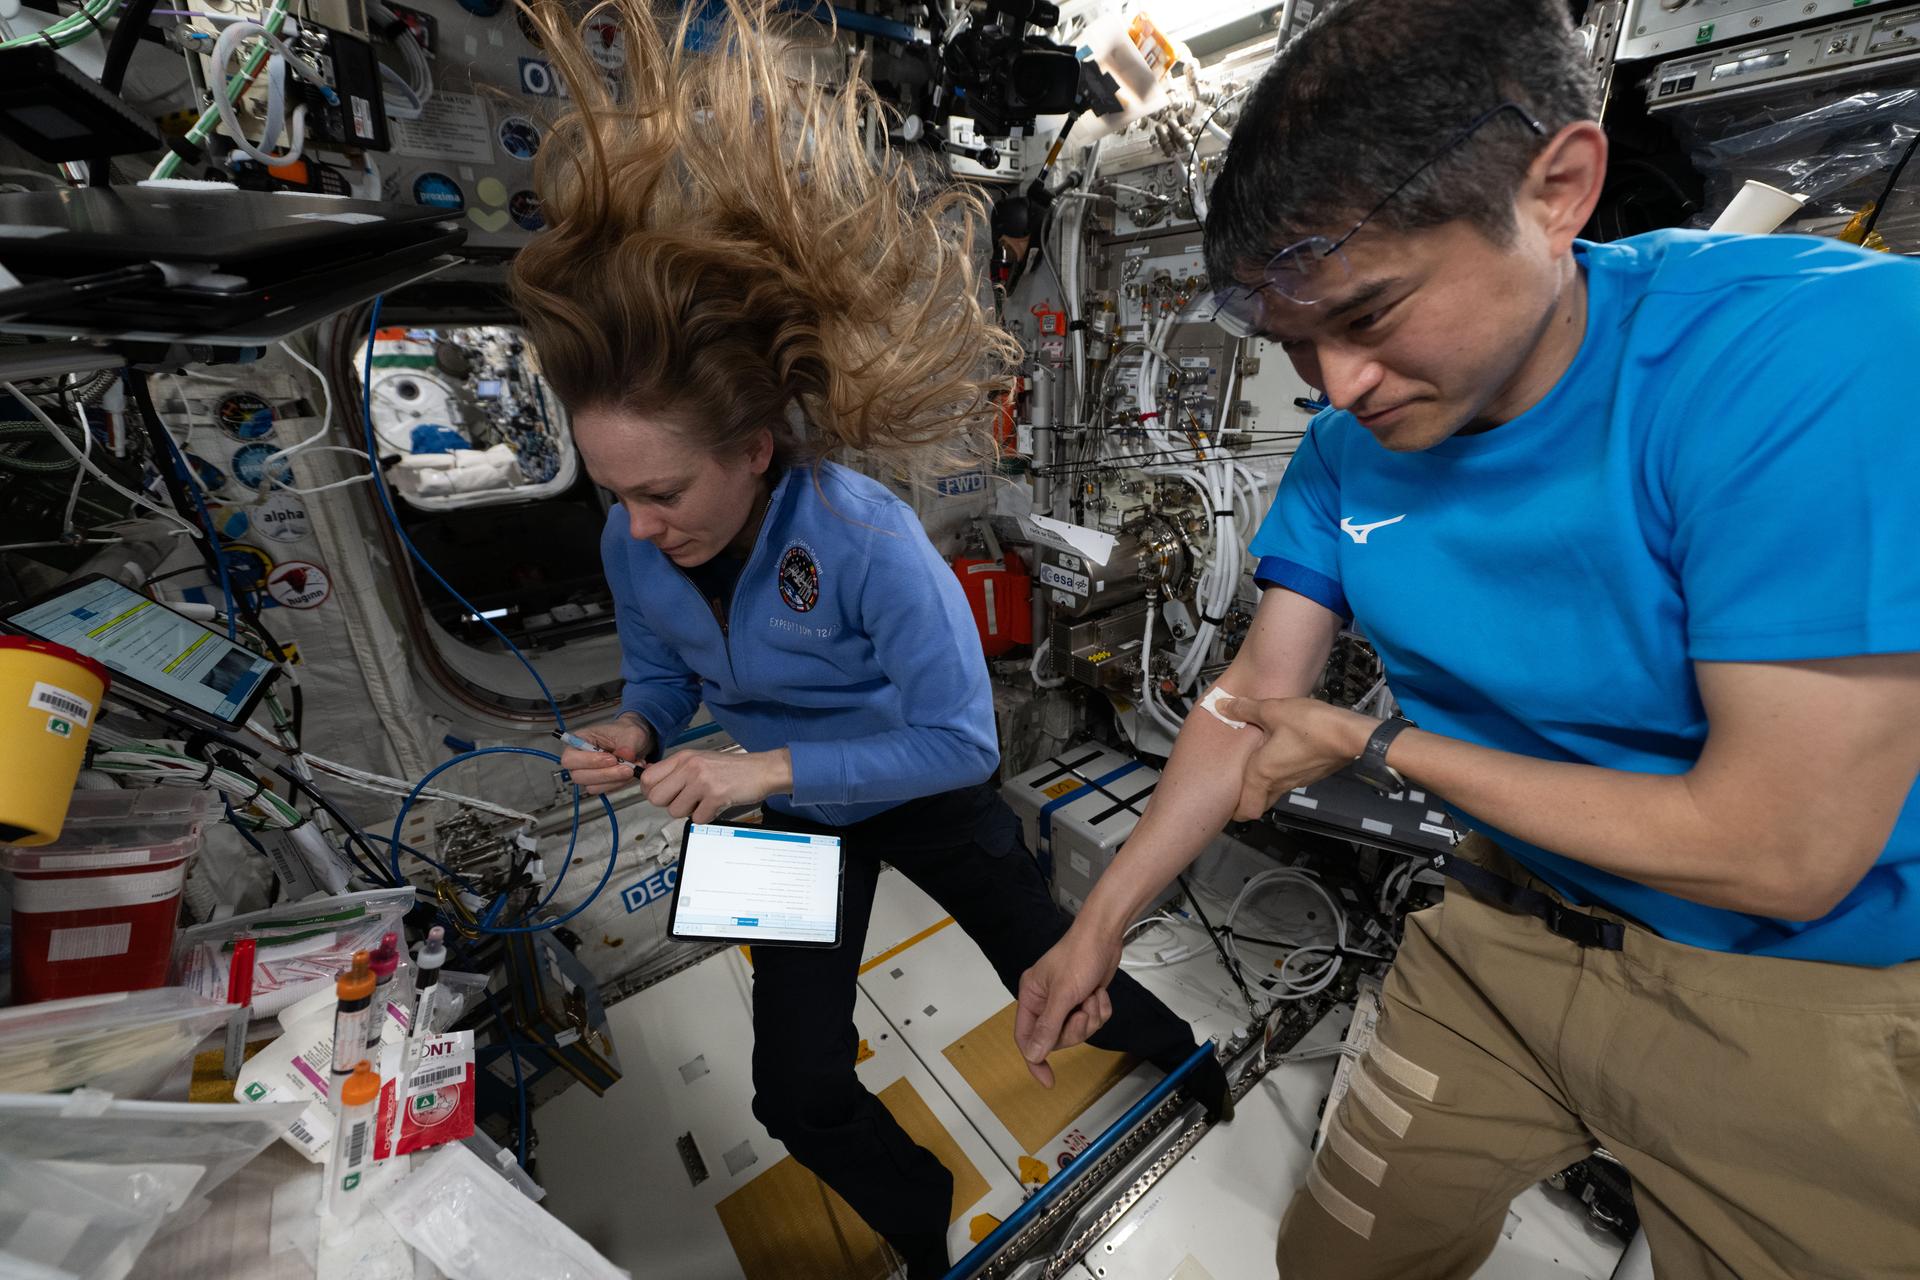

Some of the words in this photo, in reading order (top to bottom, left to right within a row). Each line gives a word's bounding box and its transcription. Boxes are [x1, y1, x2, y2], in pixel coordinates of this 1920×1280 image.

[946, 473, 982, 494] FWD
[263, 508, 305, 523] alpha
[1053, 573, 1074, 588] esa
[287, 589, 325, 607] huginn
[769, 617, 813, 637] EXPEDITION
